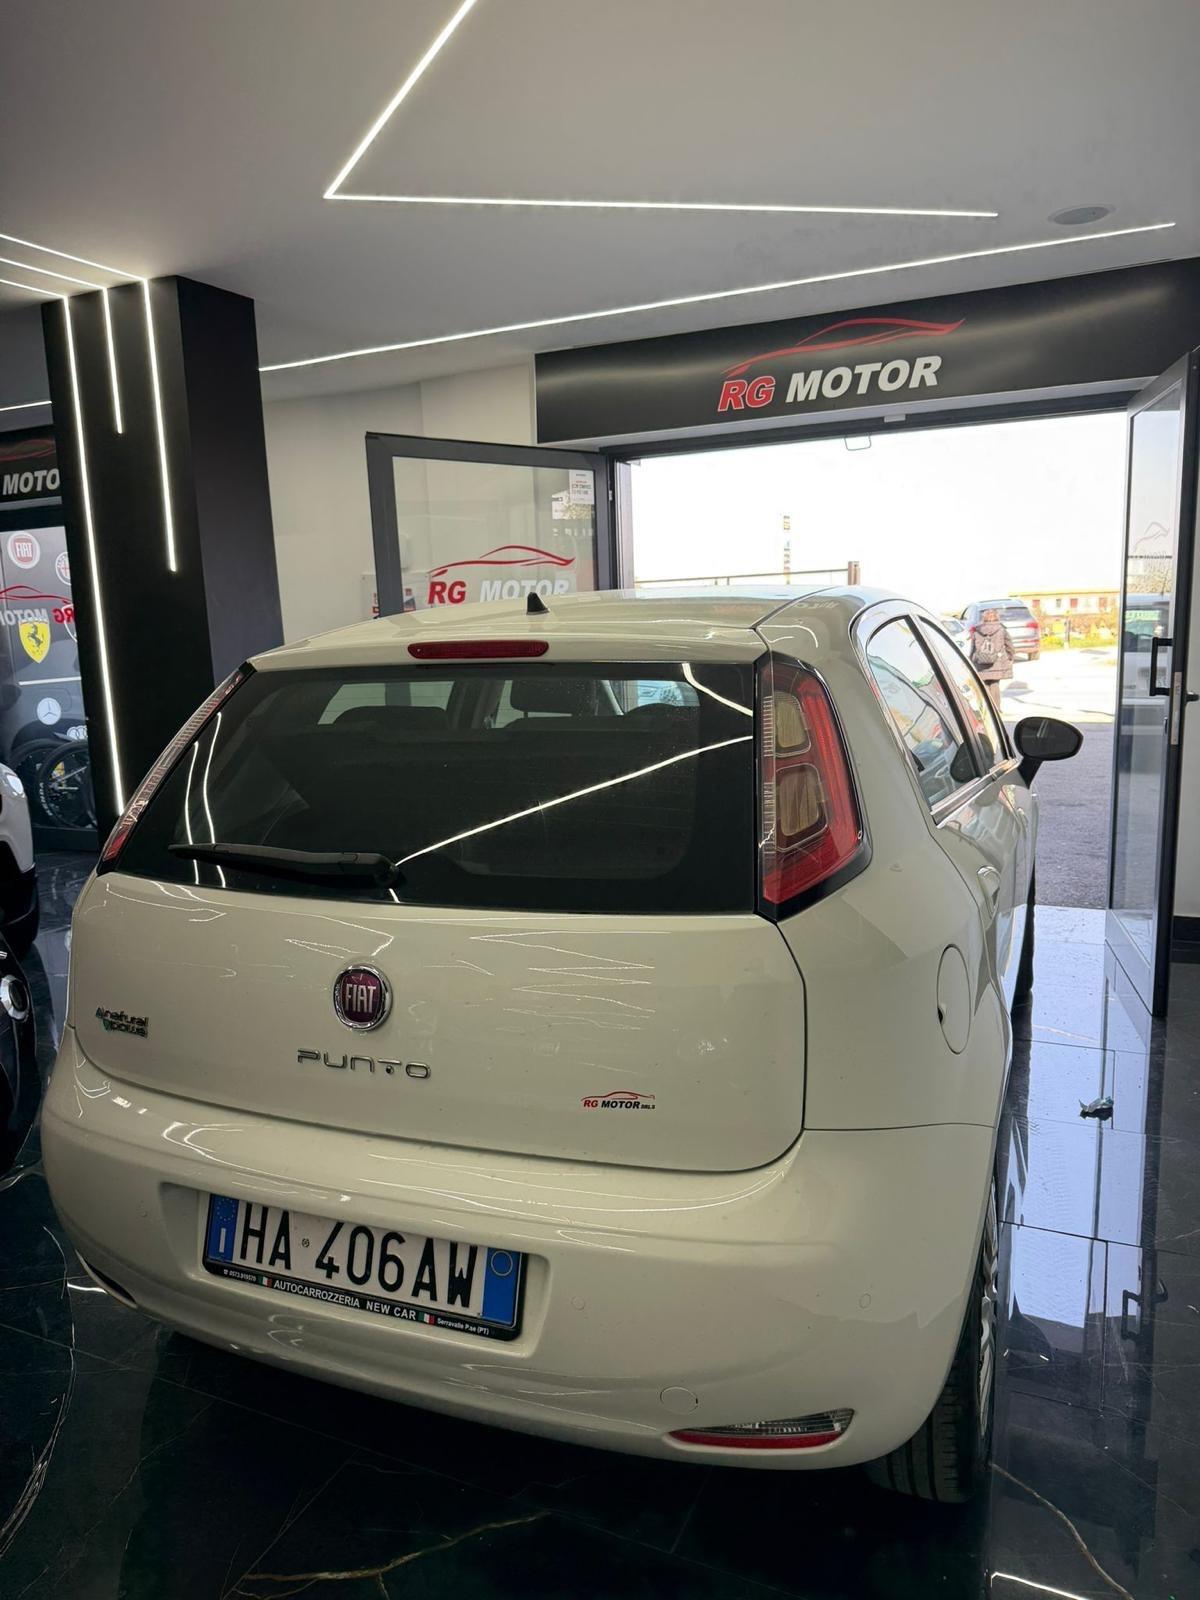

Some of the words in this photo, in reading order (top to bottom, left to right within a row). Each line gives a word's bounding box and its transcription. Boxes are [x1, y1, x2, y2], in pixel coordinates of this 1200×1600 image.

[717, 375, 777, 412] RG
[785, 355, 942, 404] MOTOR
[15, 541, 33, 558] FIAT
[427, 580, 467, 605] RG
[479, 579, 570, 604] MOTOR
[345, 983, 378, 1014] FIAT
[297, 1049, 432, 1080] PUNTO
[583, 1100, 598, 1108] RG
[601, 1100, 640, 1109] MOTOR
[239, 1202, 293, 1271] HA
[314, 1221, 479, 1309] 406AW
[273, 1279, 361, 1309] AUTOCARROZZERIA
[366, 1300, 391, 1316] NEW
[393, 1304, 417, 1321] CAR
